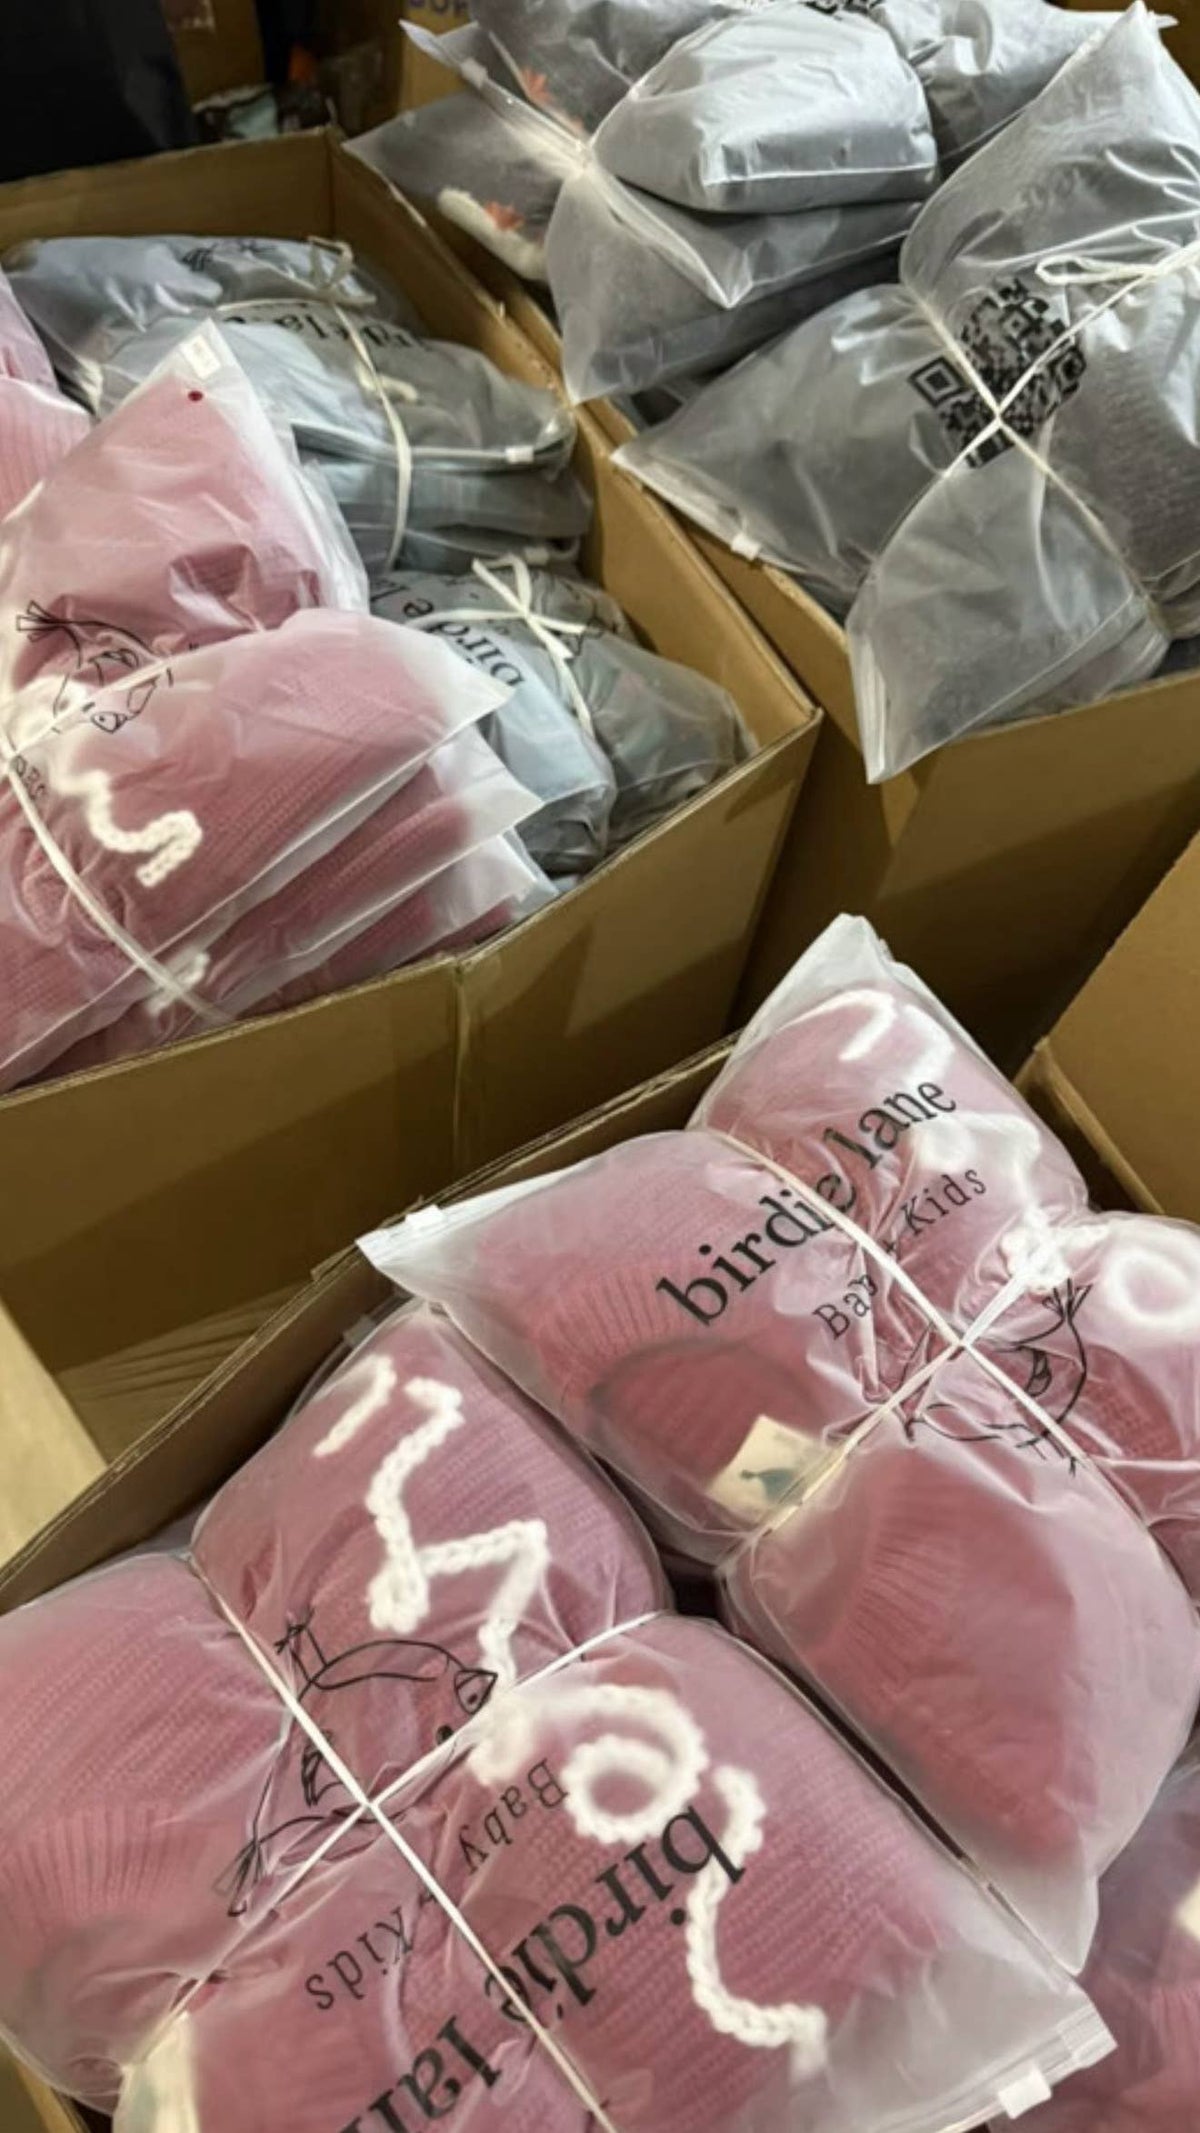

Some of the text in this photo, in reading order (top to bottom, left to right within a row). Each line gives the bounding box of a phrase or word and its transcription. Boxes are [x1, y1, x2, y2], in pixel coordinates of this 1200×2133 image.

[403, 597, 525, 687] birde
[655, 1081, 957, 1327] birdie lane
[901, 1167, 988, 1237] Kids
[457, 1758, 569, 1875] Baby
[305, 1903, 415, 2010] Kids
[485, 1805, 746, 2022] birdie
